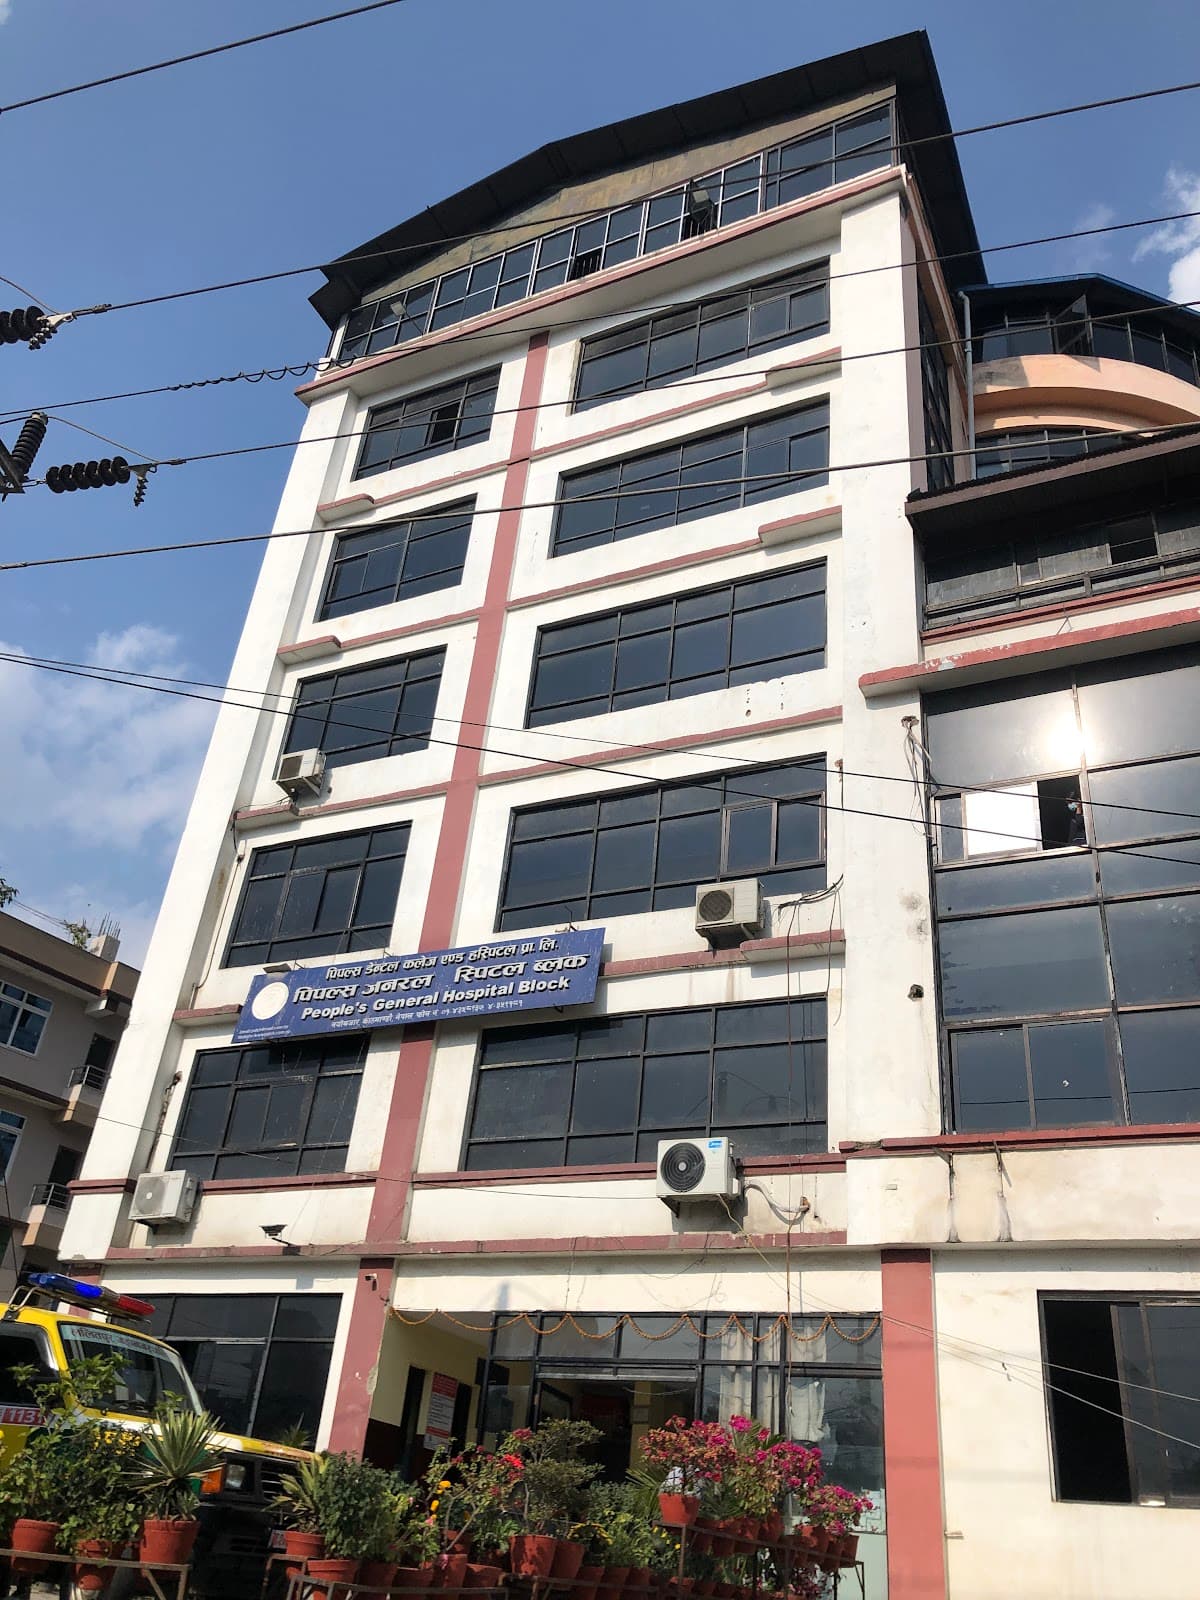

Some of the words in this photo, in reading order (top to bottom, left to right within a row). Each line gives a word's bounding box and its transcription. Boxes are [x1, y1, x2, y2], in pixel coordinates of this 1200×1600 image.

[326, 967, 362, 981] पिपल्स
[402, 954, 437, 969] कलेज
[441, 951, 465, 964] एण्ड
[293, 984, 360, 1003] पिपल्स
[301, 1002, 368, 1020] People's
[373, 991, 440, 1011] General
[442, 982, 515, 1004] Hospital
[518, 976, 571, 994] Block
